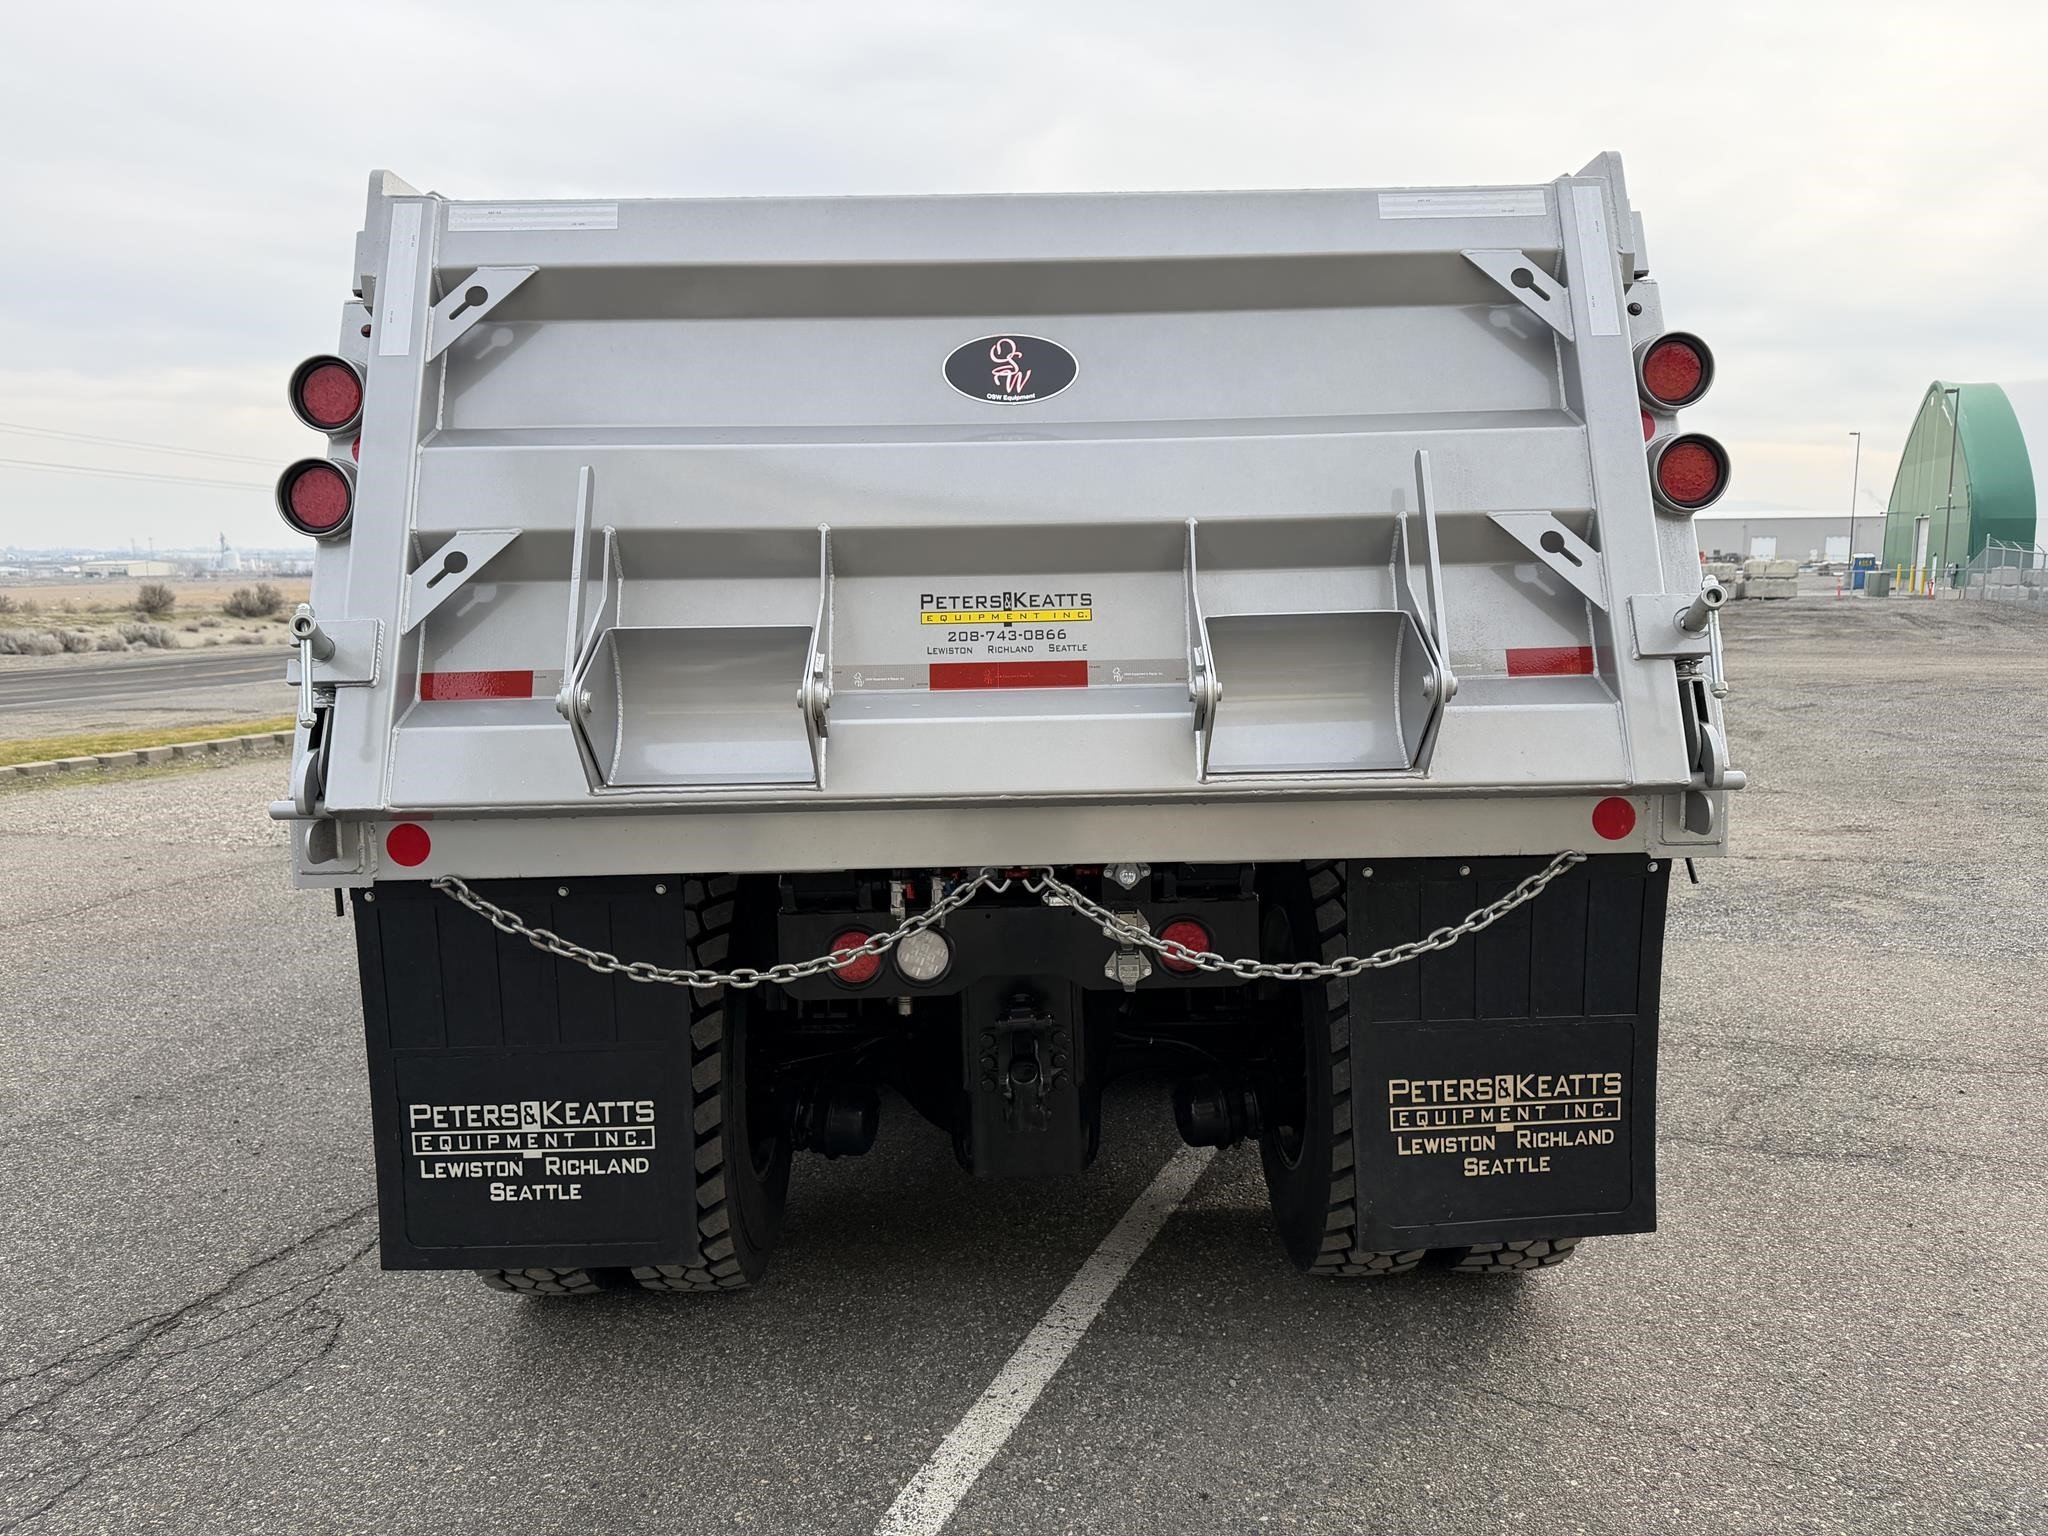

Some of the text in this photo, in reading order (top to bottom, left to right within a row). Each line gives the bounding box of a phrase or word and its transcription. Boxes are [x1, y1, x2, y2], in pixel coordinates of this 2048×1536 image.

[1003, 393, 1035, 401] Equipment
[926, 612, 1040, 622] EQUIPMENT
[948, 629, 1067, 642] 208-743-0866
[926, 643, 1088, 655] LEWISTON RICHLAND SEATTLE
[1399, 1103, 1612, 1128] EQUIPMENT INC.
[421, 1131, 646, 1152] EQUIPMENT INC.
[1398, 1129, 1615, 1155] LEWISTON RICHLAND
[420, 1157, 649, 1178] LEWISTON RICHLAND
[1464, 1157, 1551, 1176] SEATTLE
[490, 1183, 582, 1201] SEATTLE
